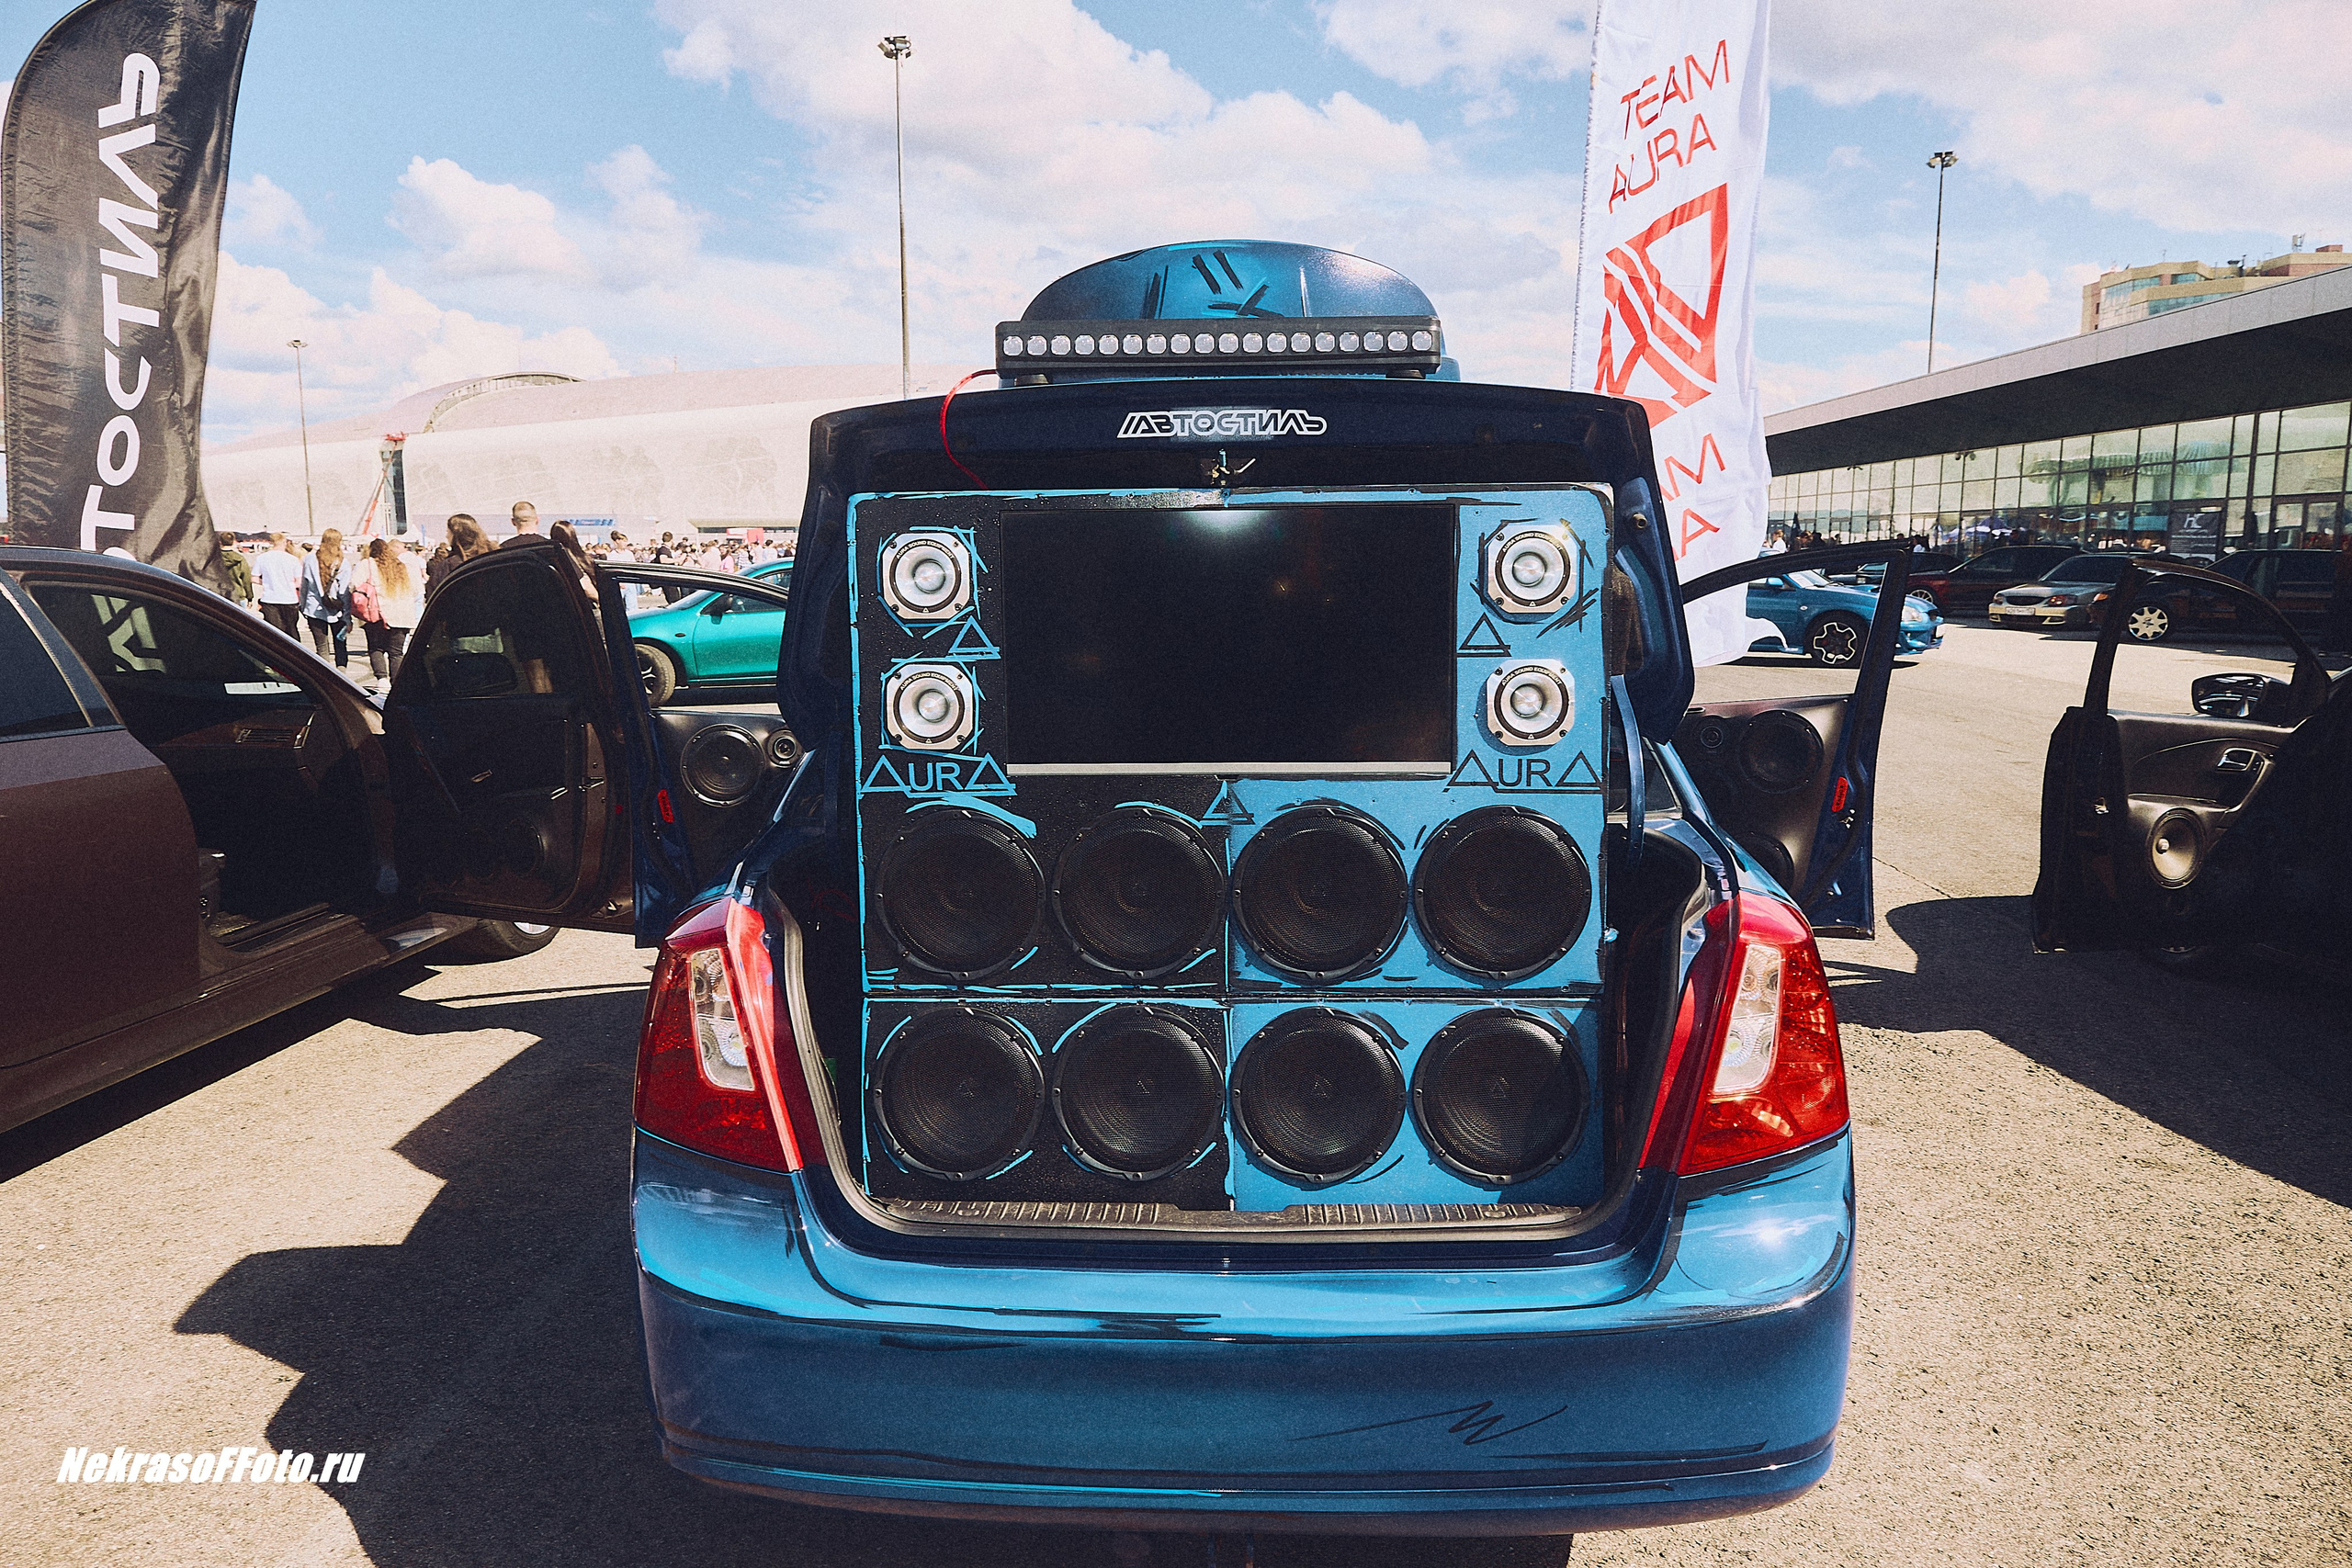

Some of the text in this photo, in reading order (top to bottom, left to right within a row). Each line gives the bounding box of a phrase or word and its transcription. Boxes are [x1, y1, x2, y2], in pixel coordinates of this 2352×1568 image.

[1620, 39, 1730, 140] TEAM
[1608, 113, 1717, 214] AURA
[80, 52, 161, 561] ТОСТИЛЬ
[1116, 410, 1328, 438] АВТОСТИЛЬ
[896, 547, 909, 558] AURA
[909, 540, 927, 549] SOUND
[1502, 538, 1514, 552] AURA
[899, 677, 913, 691] AURA
[912, 672, 931, 681] SOUND
[1501, 673, 1515, 686] AURA
[860, 752, 1017, 798] AURA
[1446, 749, 1602, 794] AURA
